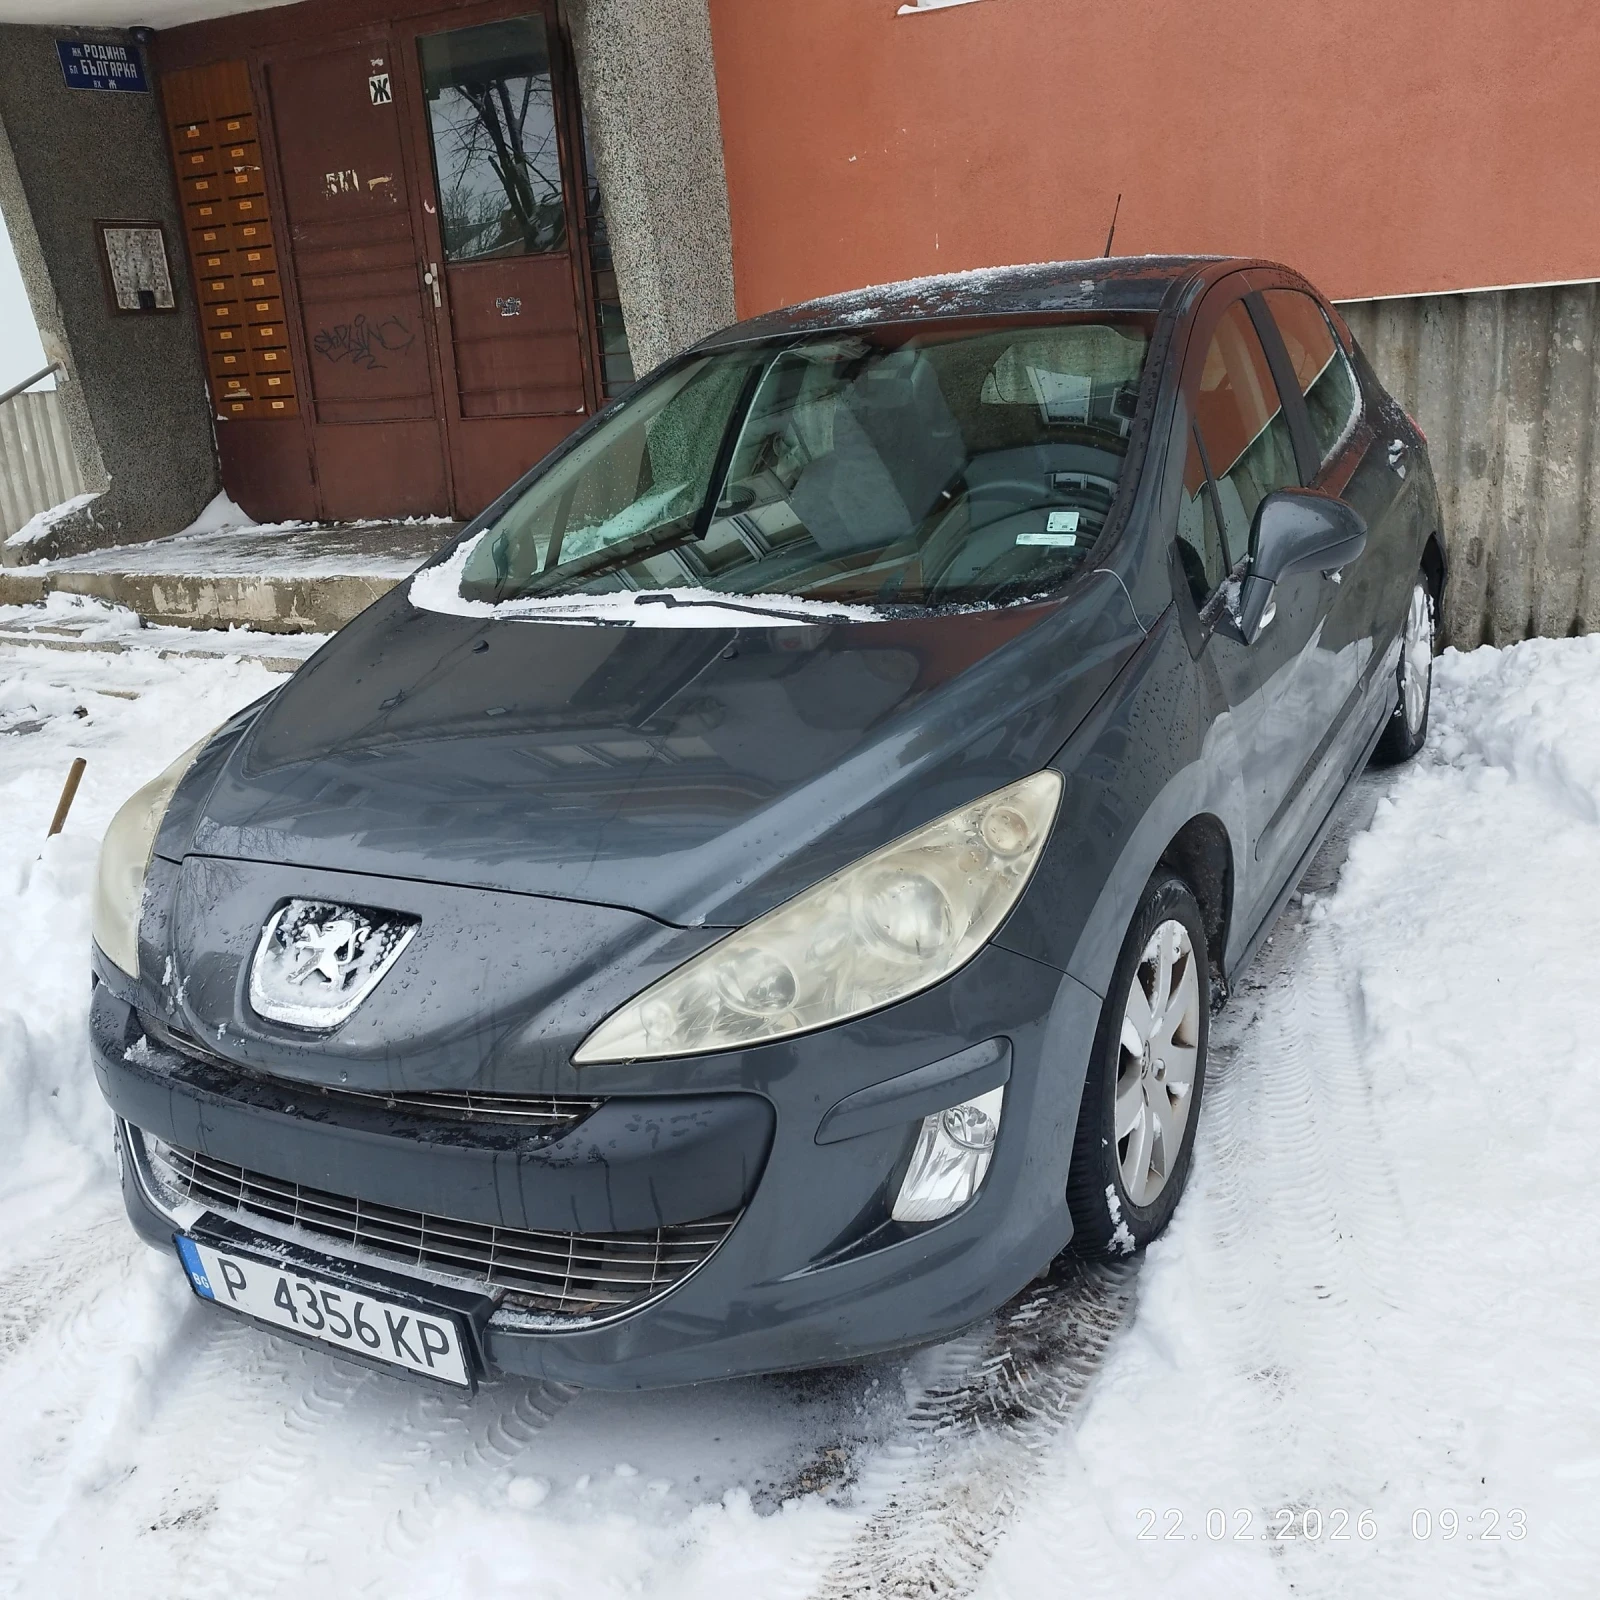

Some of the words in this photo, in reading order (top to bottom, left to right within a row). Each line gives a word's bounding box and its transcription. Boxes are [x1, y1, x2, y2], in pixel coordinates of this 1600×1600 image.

[83, 44, 127, 61] РОДИНА
[80, 59, 138, 79] БЪЛГАРКА
[108, 79, 117, 89] Ж
[371, 77, 391, 103] Ж
[192, 1273, 210, 1290] BG
[217, 1256, 247, 1301] P
